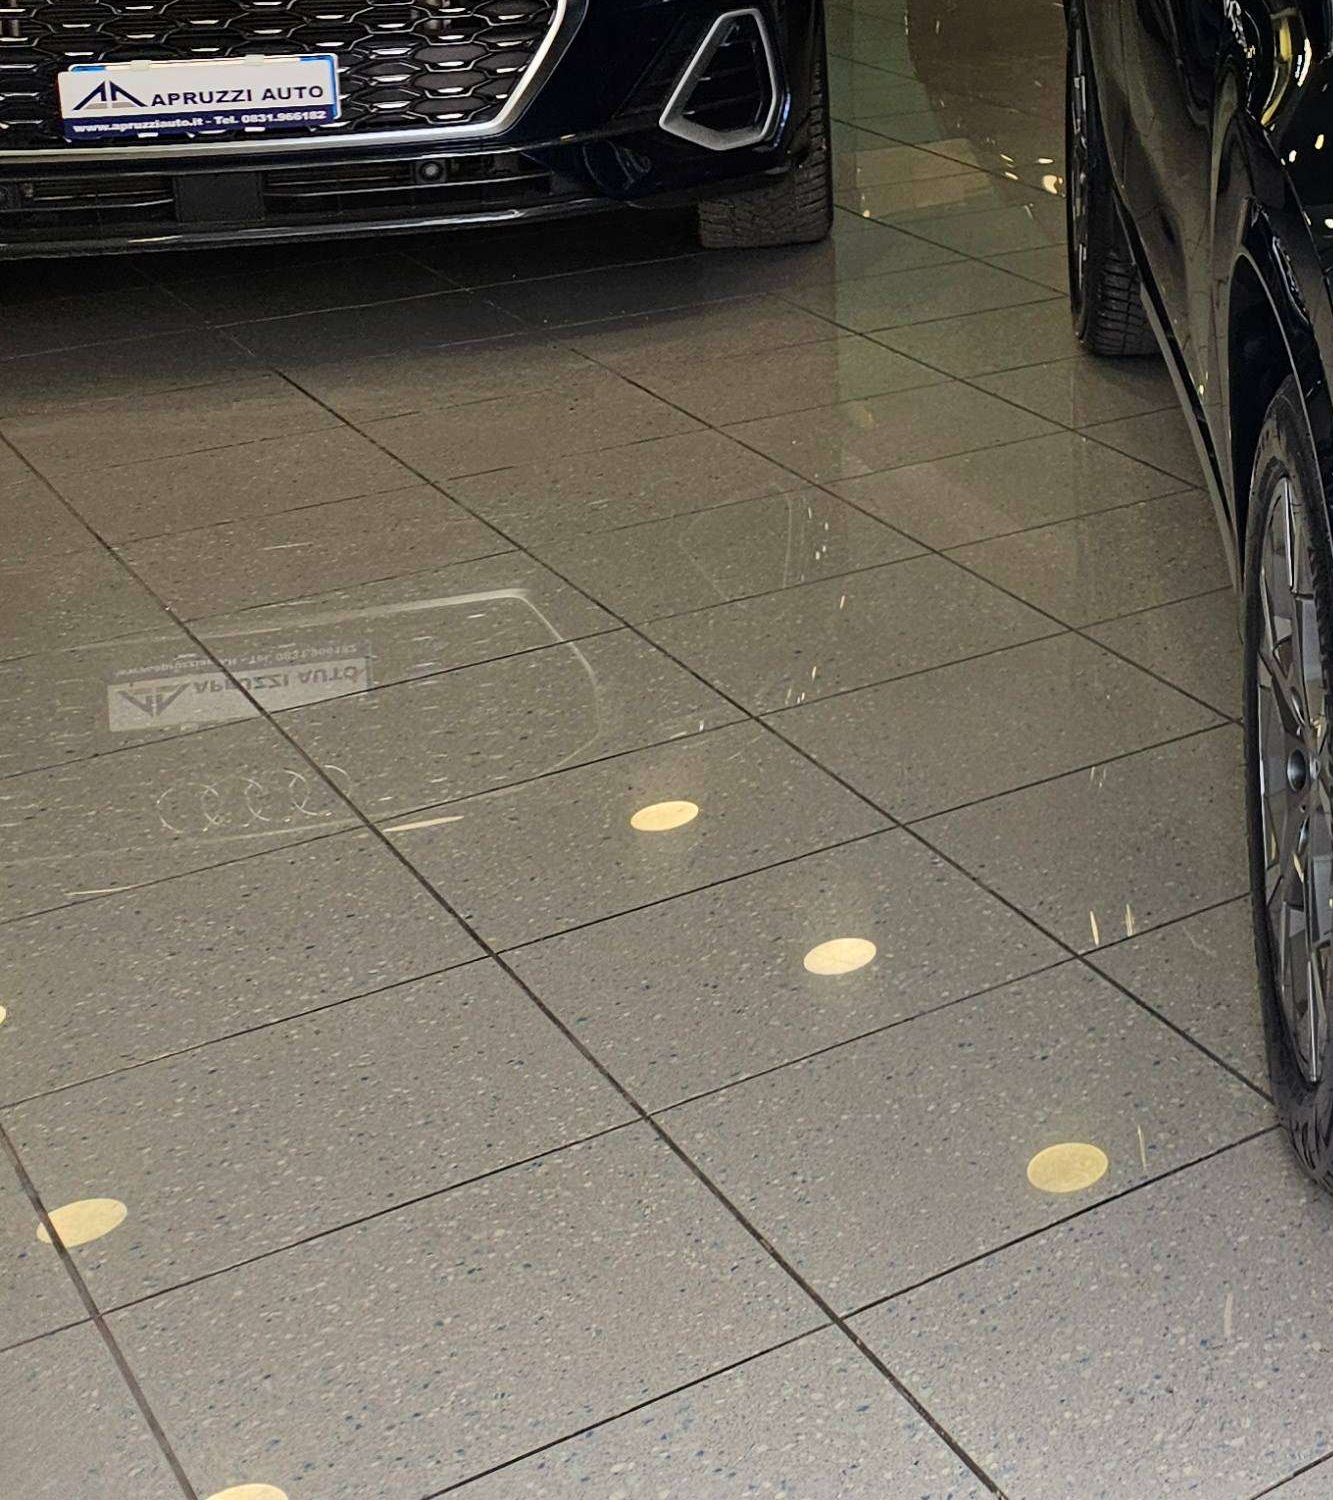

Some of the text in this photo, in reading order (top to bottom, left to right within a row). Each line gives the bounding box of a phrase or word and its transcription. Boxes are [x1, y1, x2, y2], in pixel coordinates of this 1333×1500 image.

[150, 85, 324, 107] APRUZZI AUTO
[72, 117, 204, 133] www.apruzziauto.it
